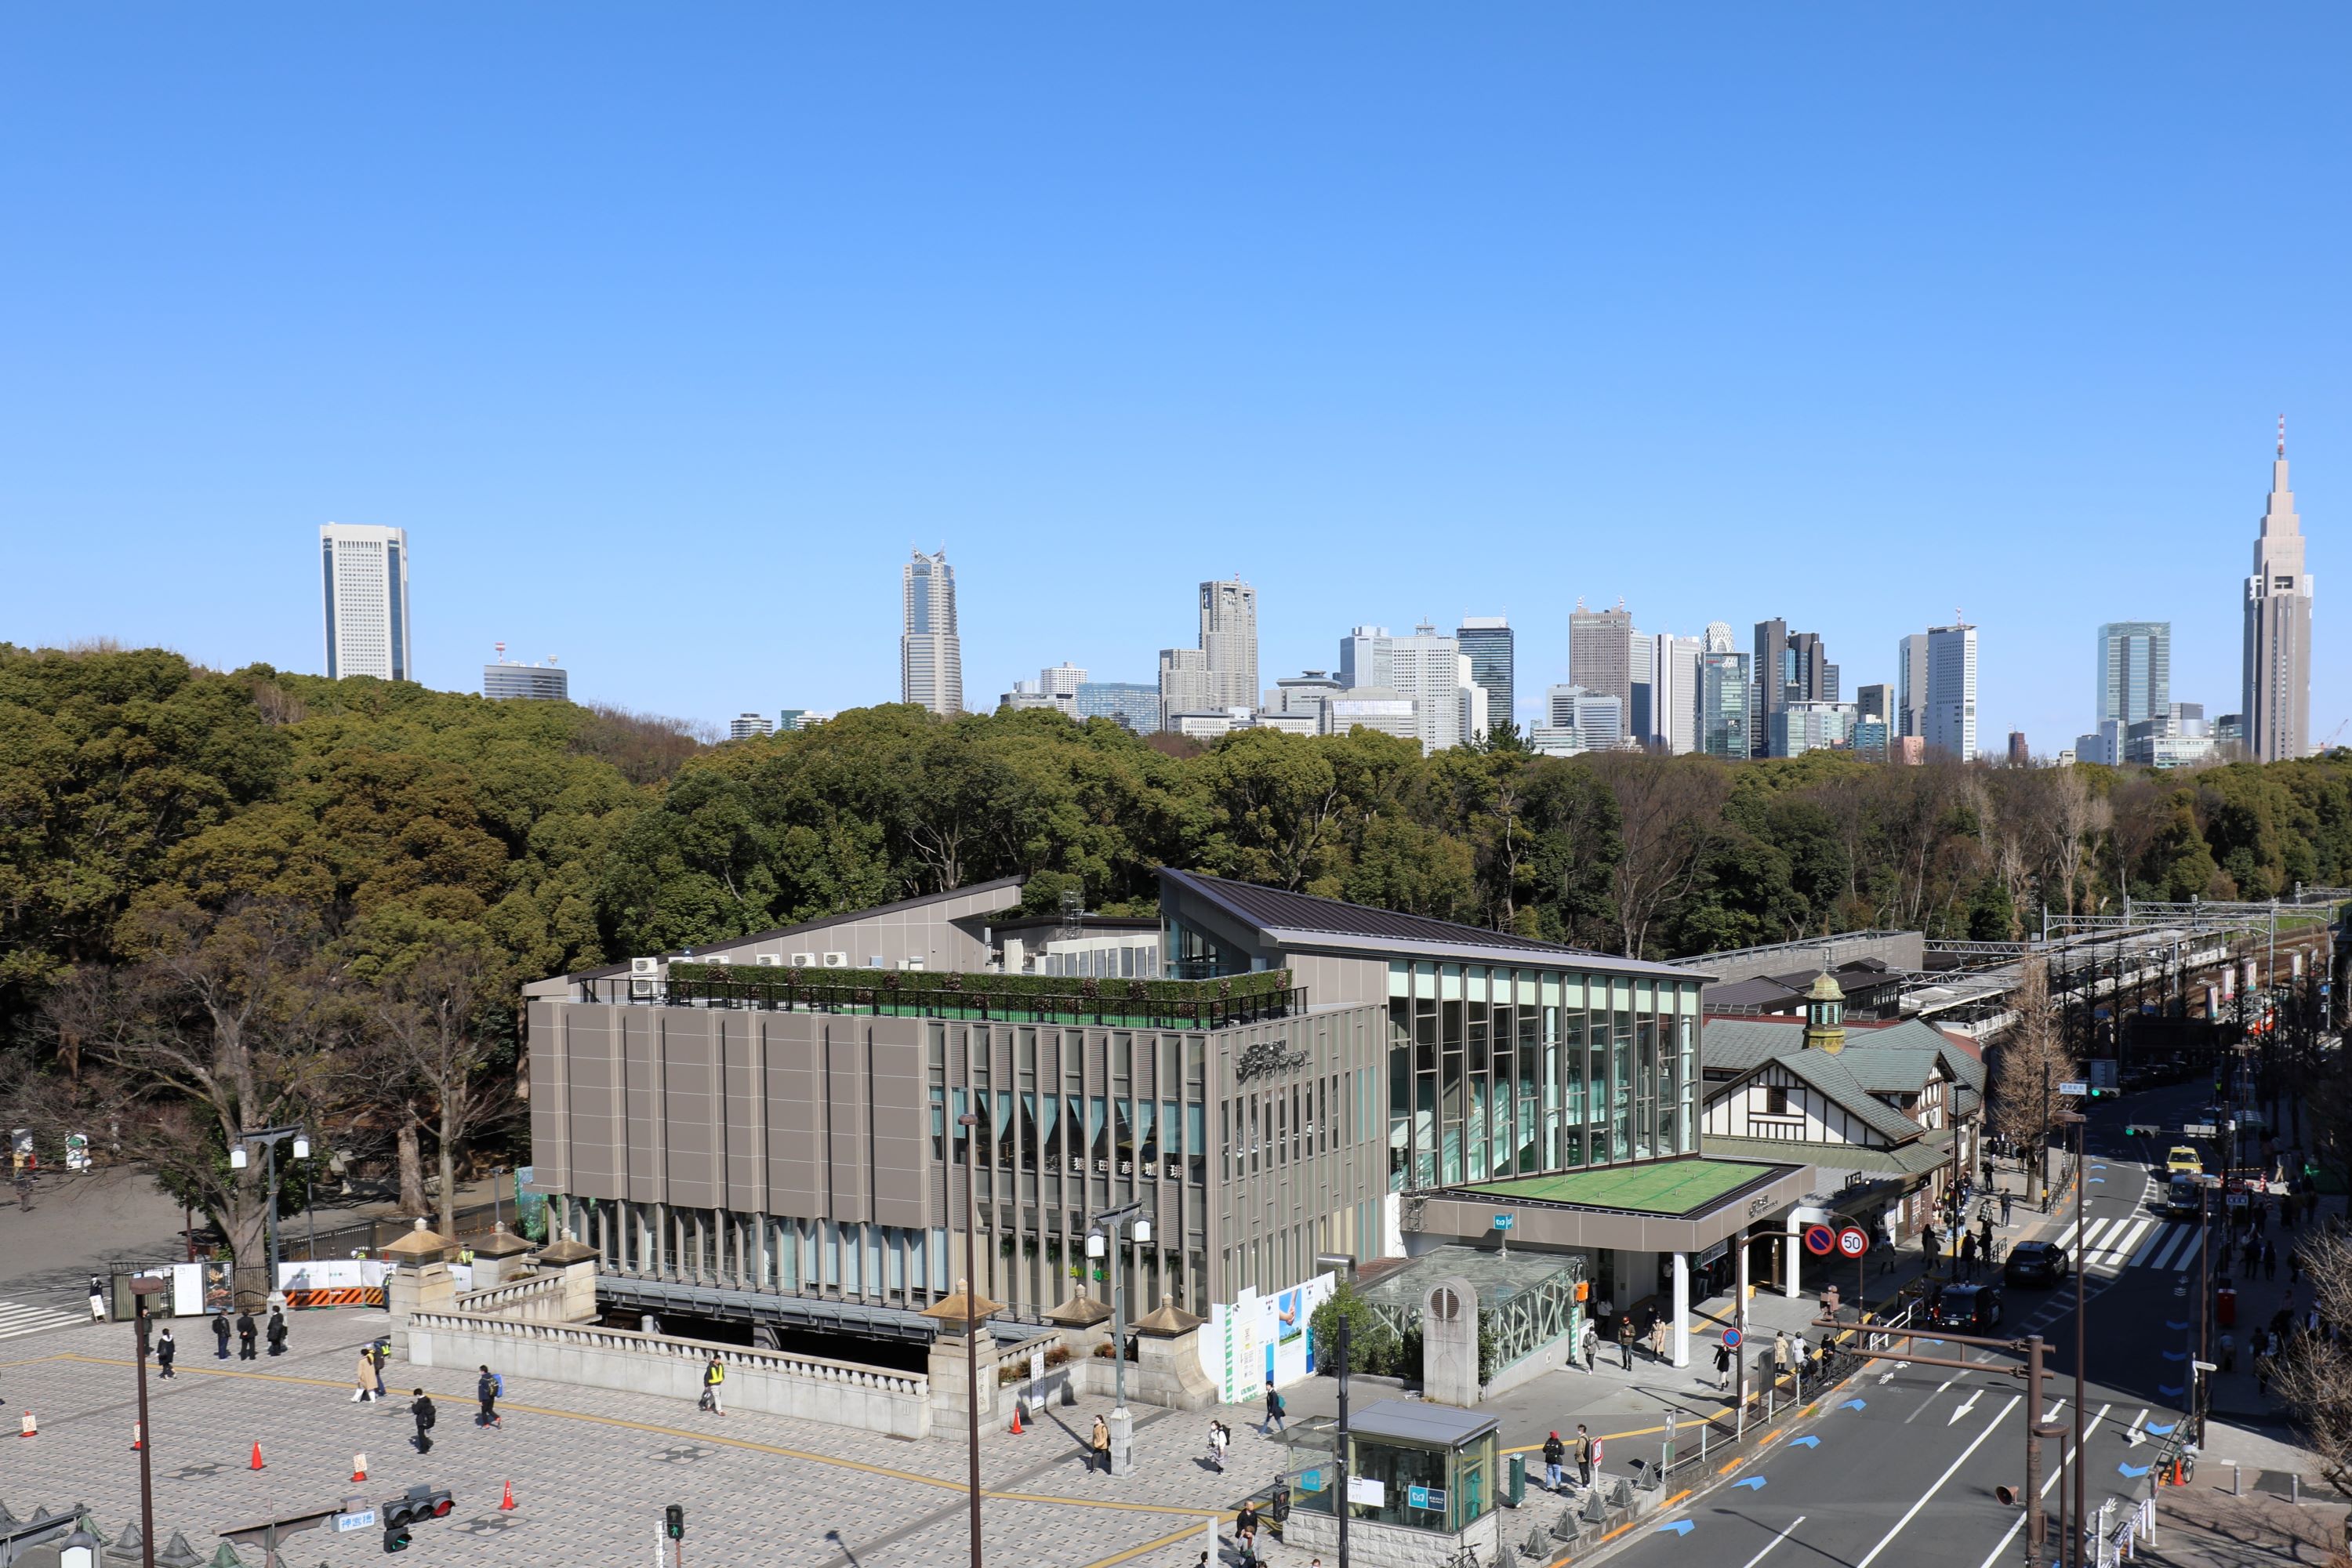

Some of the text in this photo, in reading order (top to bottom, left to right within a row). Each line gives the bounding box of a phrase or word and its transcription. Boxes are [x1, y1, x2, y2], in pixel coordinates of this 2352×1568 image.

[1074, 1156, 1182, 1178] 猿田彦珈琲
[1844, 1236, 1860, 1250] 50
